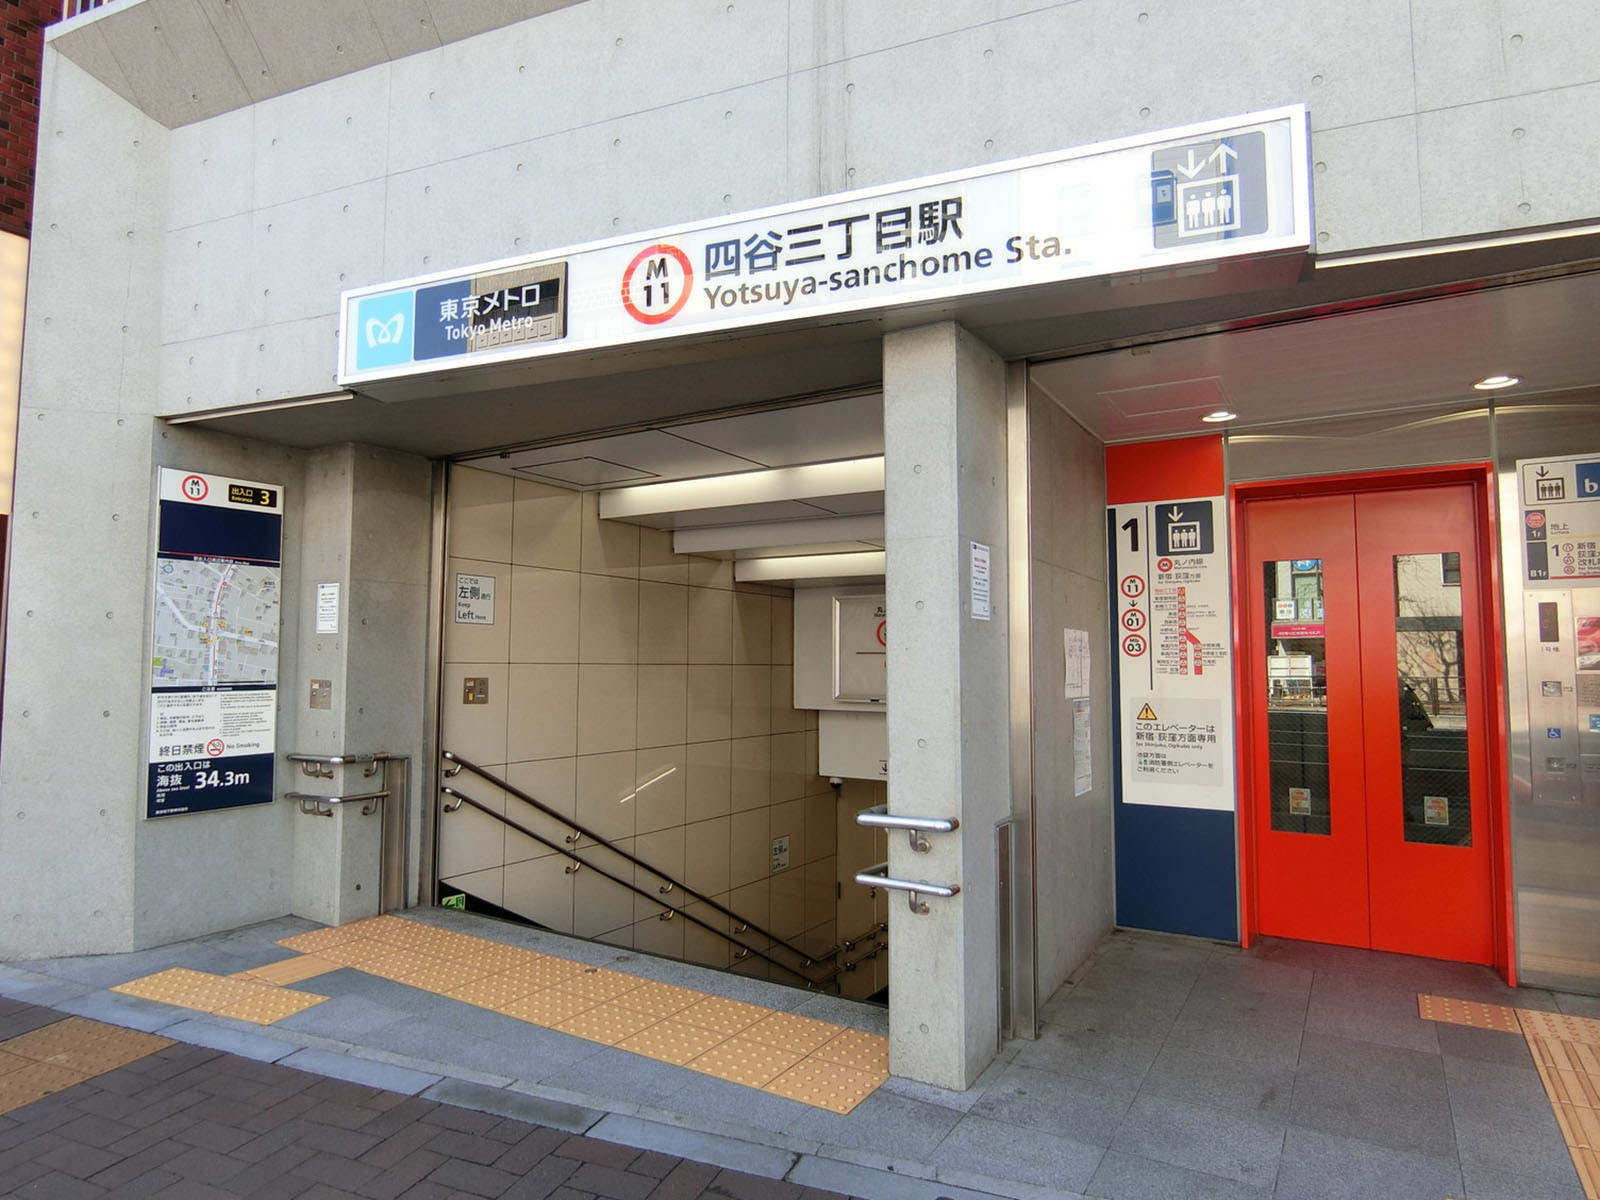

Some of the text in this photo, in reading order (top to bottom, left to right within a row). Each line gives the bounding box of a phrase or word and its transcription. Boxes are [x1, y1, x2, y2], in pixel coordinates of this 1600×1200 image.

[704, 196, 965, 282] 四谷三丁目駅
[703, 234, 1073, 311] Yotsuya-sanchome Sta.
[643, 282, 670, 307] 11
[439, 283, 541, 322] 東京メトロ
[445, 315, 534, 341] Tokyo Metro
[190, 487, 200, 496] 11
[231, 487, 270, 505] 出入口 3
[1121, 518, 1139, 552] 1
[1551, 544, 1559, 557] 1
[1174, 558, 1204, 566] 丸ノ内線
[1126, 584, 1139, 593] 11
[457, 610, 475, 620] Left
[1126, 618, 1140, 627] 01
[1127, 643, 1142, 653] 03
[1135, 722, 1216, 733] このエレベーターは
[159, 743, 205, 757] 終日禁煙
[236, 741, 260, 749] Smoking
[157, 760, 211, 773] この出入口は
[156, 770, 250, 790] 海抜 34.3m
